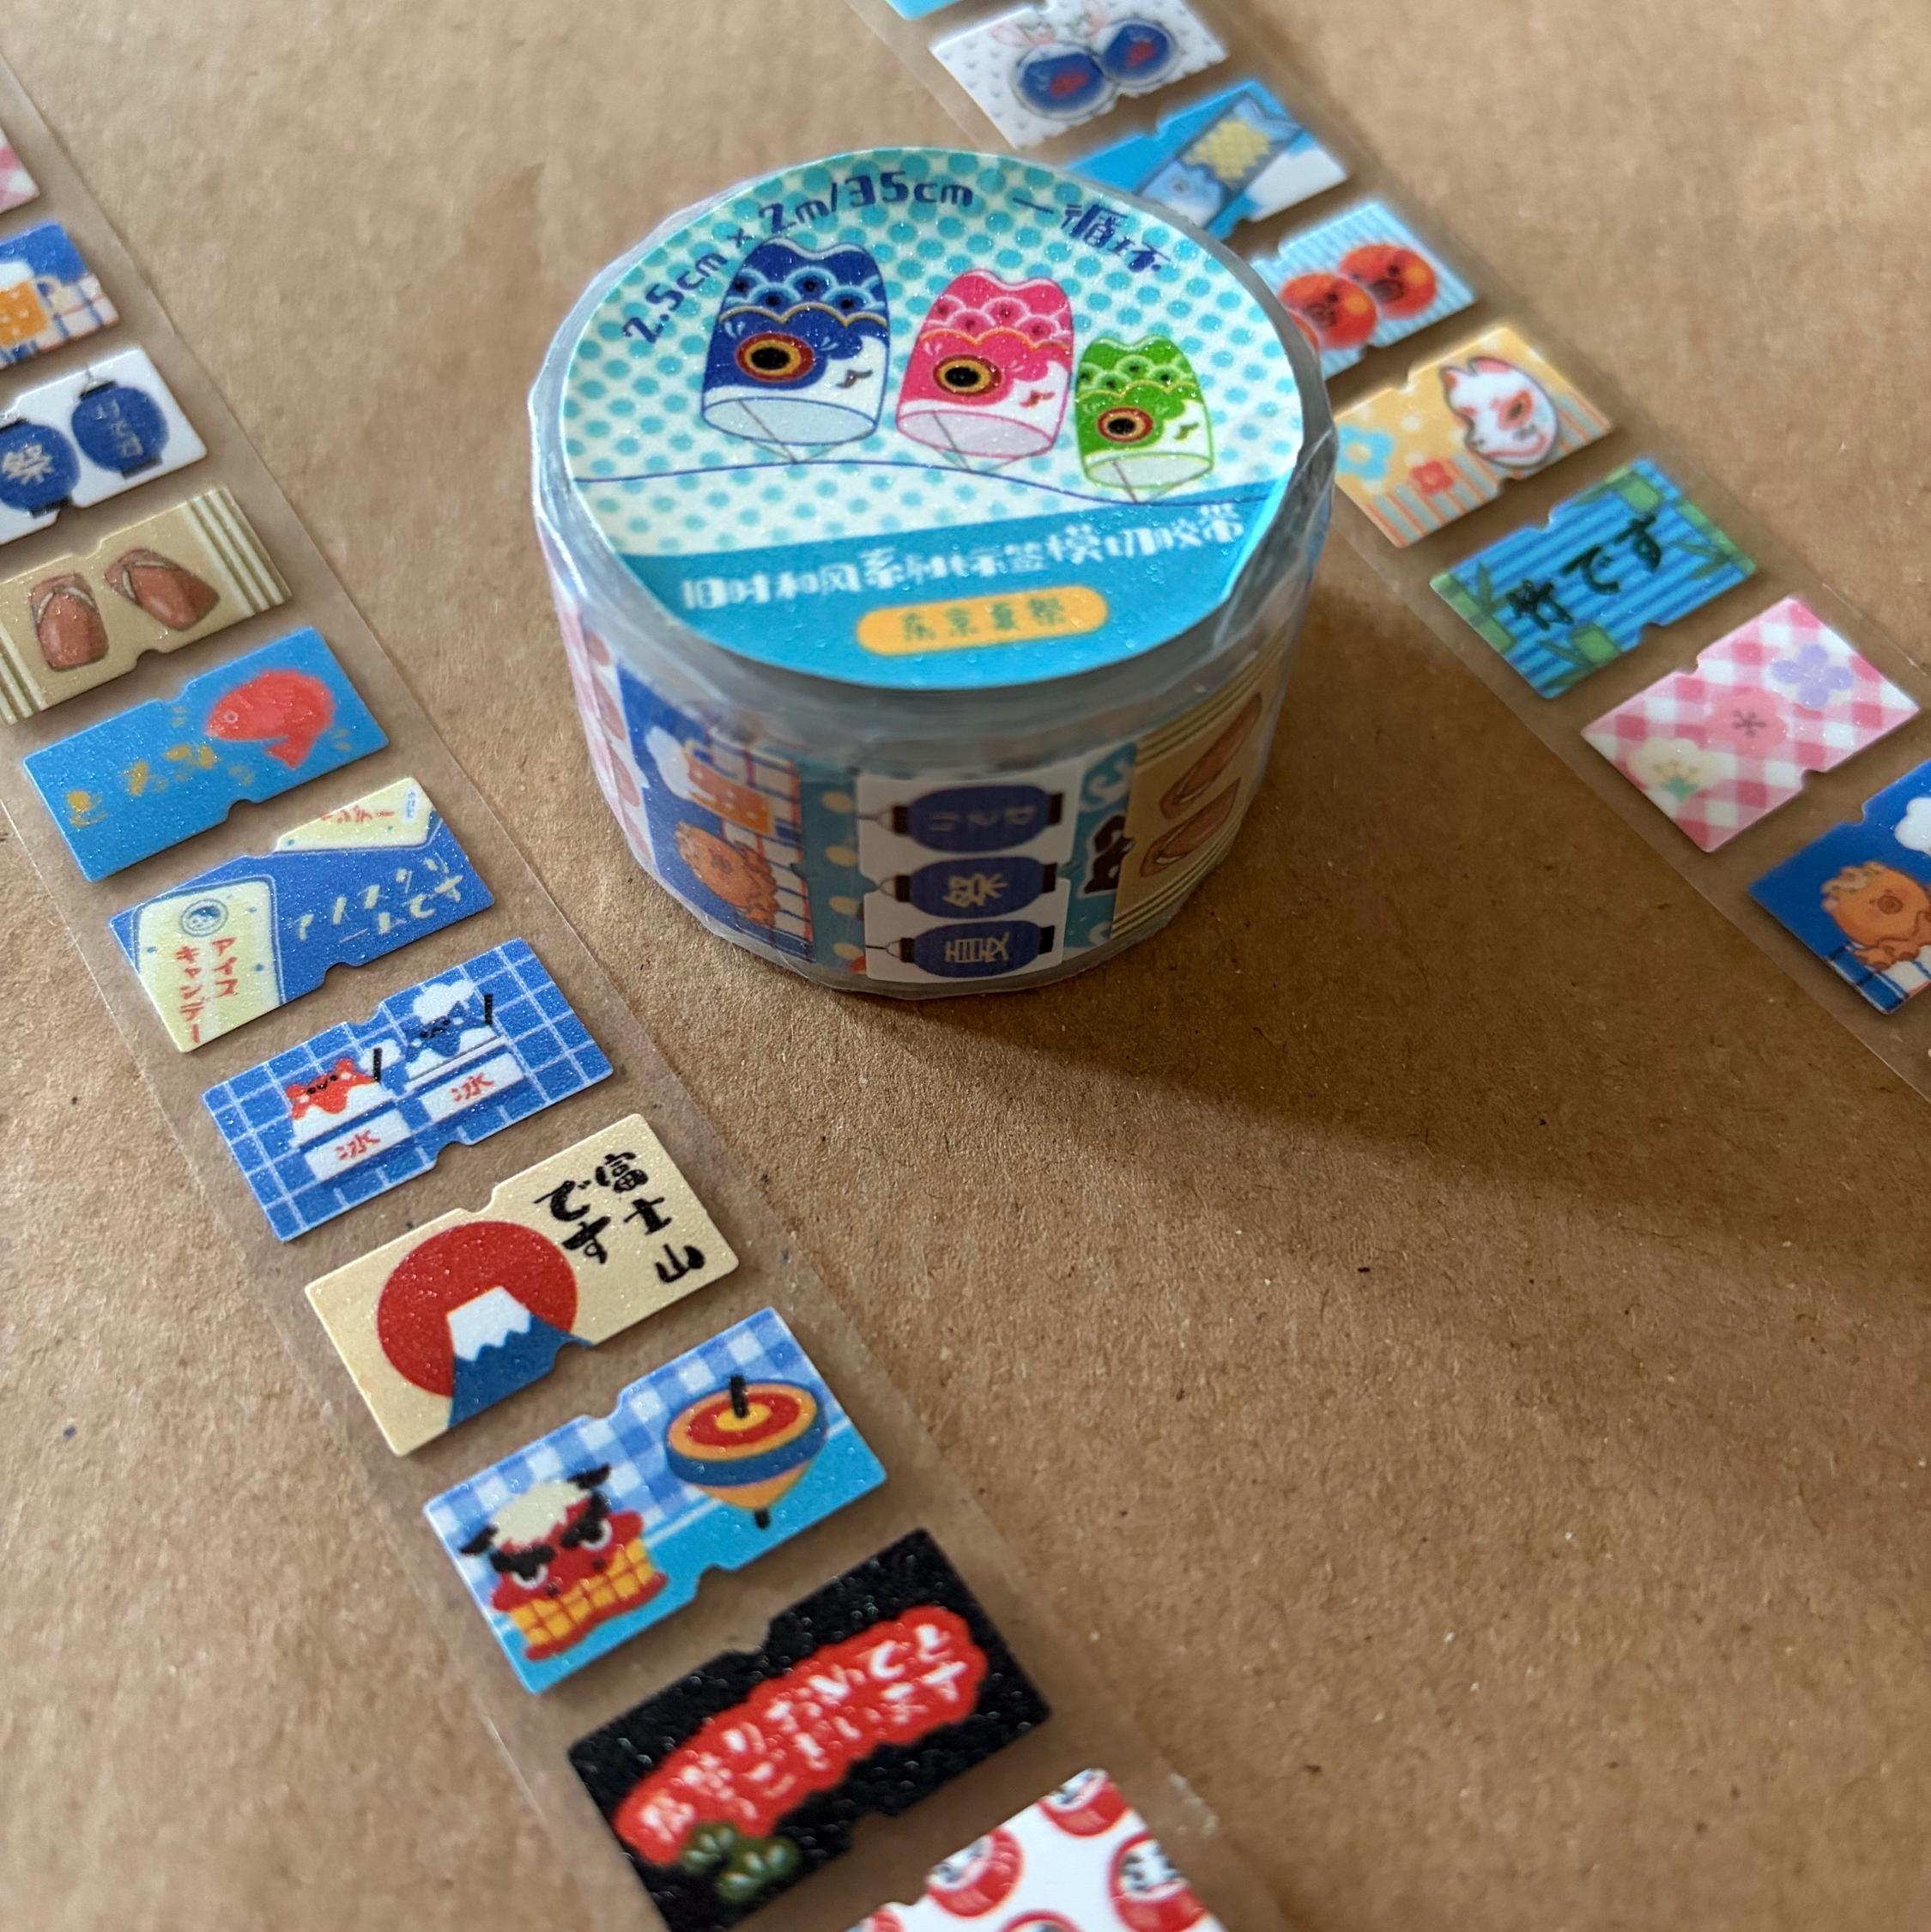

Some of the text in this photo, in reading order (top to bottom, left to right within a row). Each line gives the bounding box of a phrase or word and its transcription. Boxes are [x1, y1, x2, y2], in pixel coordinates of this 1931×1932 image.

[622, 252, 729, 344] 2.5cm
[758, 171, 974, 233] 2m/35cm
[211, 936, 239, 998] アイス
[534, 1179, 612, 1264] です
[595, 1151, 706, 1284] 富士山
